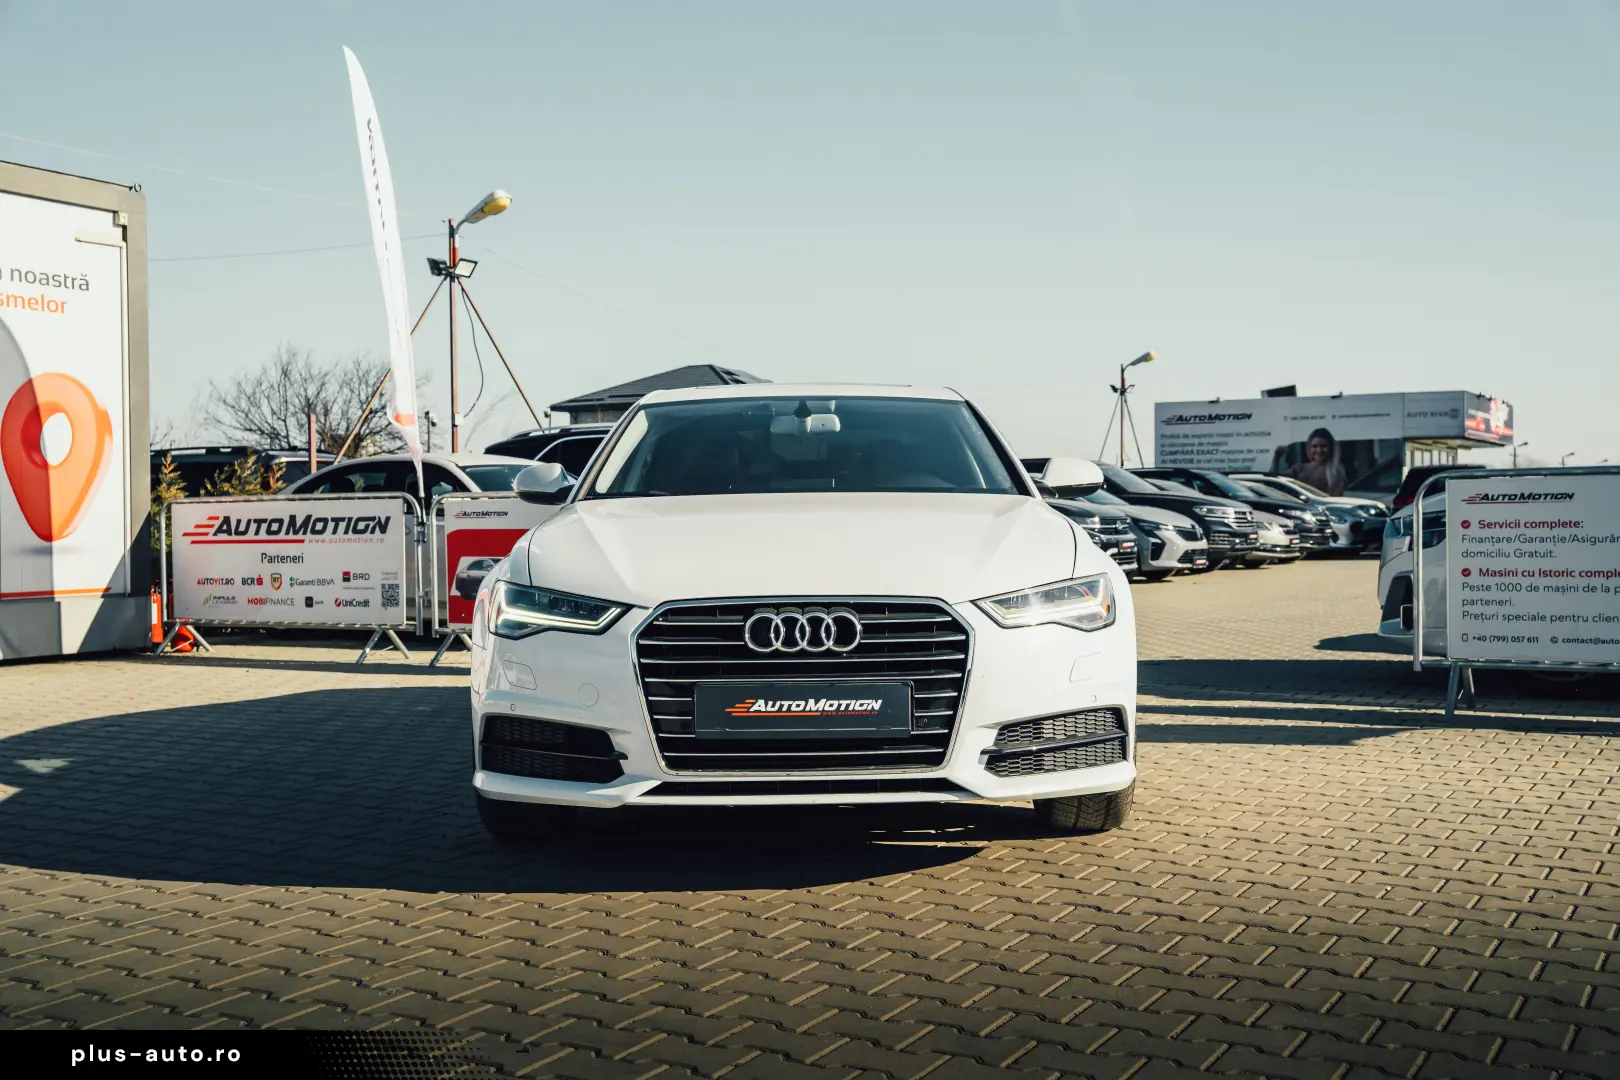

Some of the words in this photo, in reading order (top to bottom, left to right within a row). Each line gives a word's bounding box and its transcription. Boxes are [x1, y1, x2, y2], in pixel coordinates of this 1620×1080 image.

[10, 267, 90, 292] noastră
[1478, 492, 1575, 501] AUTOMOTION
[212, 514, 391, 536] AUTOMOTION
[1478, 519, 1521, 529] Servicii
[1523, 519, 1584, 531] complete:
[261, 552, 304, 564] Parteneri
[1461, 548, 1511, 558] domiciliu
[1513, 548, 1557, 559] Gratuit.
[352, 572, 371, 581] BRD
[1479, 567, 1518, 578] Masini
[1521, 570, 1535, 578] cu
[1538, 567, 1576, 578] Istoric
[241, 577, 255, 586] BCR
[295, 577, 316, 586] Garanti
[1462, 582, 1492, 592] Peste
[1494, 582, 1522, 592] 1000
[1525, 582, 1540, 593] de
[1543, 583, 1579, 596] mașini
[1582, 583, 1598, 593] de
[1600, 583, 1611, 594] la
[247, 597, 295, 606] MOBIFINANCE
[342, 598, 370, 607] UniCredit
[1462, 597, 1515, 608] parteneri.
[1462, 610, 1499, 623] Prețuri
[1501, 611, 1547, 623] speciale
[1550, 612, 1589, 624] pentru
[1592, 612, 1620, 624] clien
[1472, 634, 1487, 642] +40
[1488, 634, 1509, 644] (799)
[1510, 635, 1525, 643] 057
[1526, 636, 1539, 644] 611
[749, 698, 882, 712] AUTOMOTION
